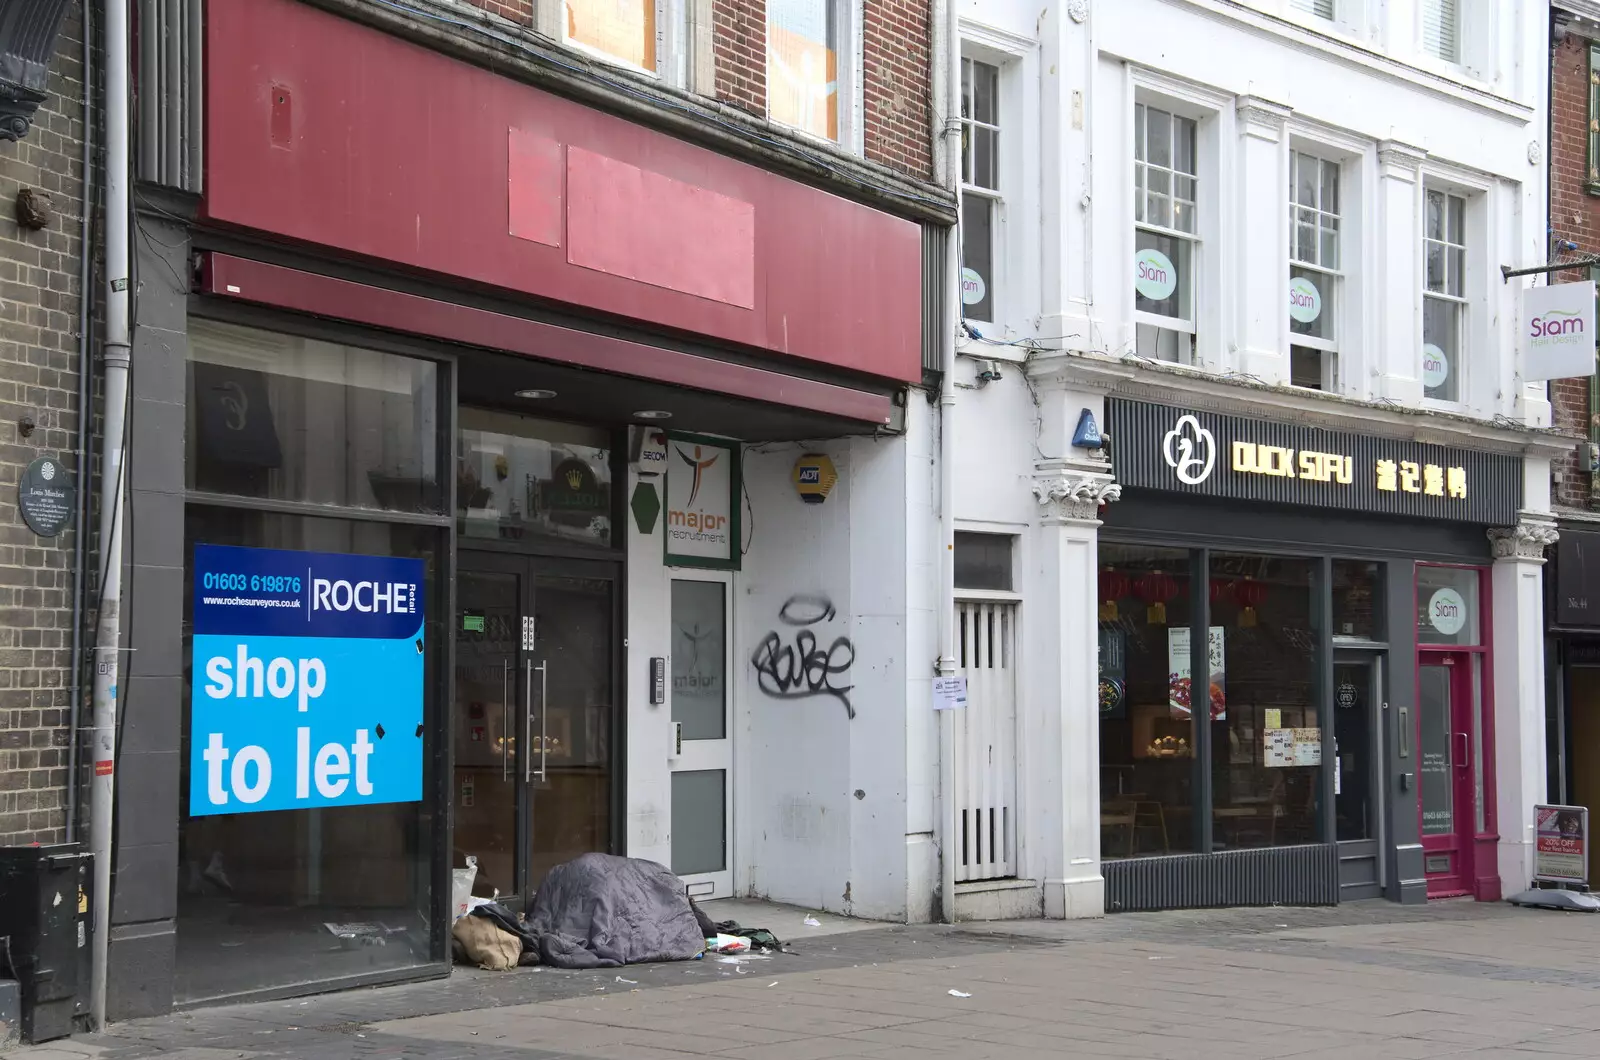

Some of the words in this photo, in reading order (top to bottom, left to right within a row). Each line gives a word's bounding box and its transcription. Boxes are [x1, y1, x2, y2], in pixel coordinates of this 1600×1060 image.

[1138, 261, 1167, 285] Siam
[1290, 288, 1314, 309] Siam
[1531, 317, 1583, 337] Siam
[1552, 334, 1584, 345] Design
[1423, 359, 1442, 373] iam
[643, 450, 666, 461] SECOM
[1232, 441, 1295, 478] DUCK
[1299, 450, 1353, 484] SIFU
[800, 470, 818, 480] ADT
[668, 508, 726, 532] major
[668, 530, 726, 543] recruitment
[203, 572, 247, 591] 01603
[250, 574, 301, 593] 619876
[203, 596, 301, 608] www.rochesurveyors.co.uk
[313, 578, 408, 614] ROCHE
[1435, 601, 1458, 618] Siam
[204, 644, 327, 712] shop
[674, 671, 718, 690] major
[203, 732, 272, 805] to
[296, 727, 374, 798] let
[1545, 838, 1560, 846] 20%
[1561, 839, 1576, 847] OFF
